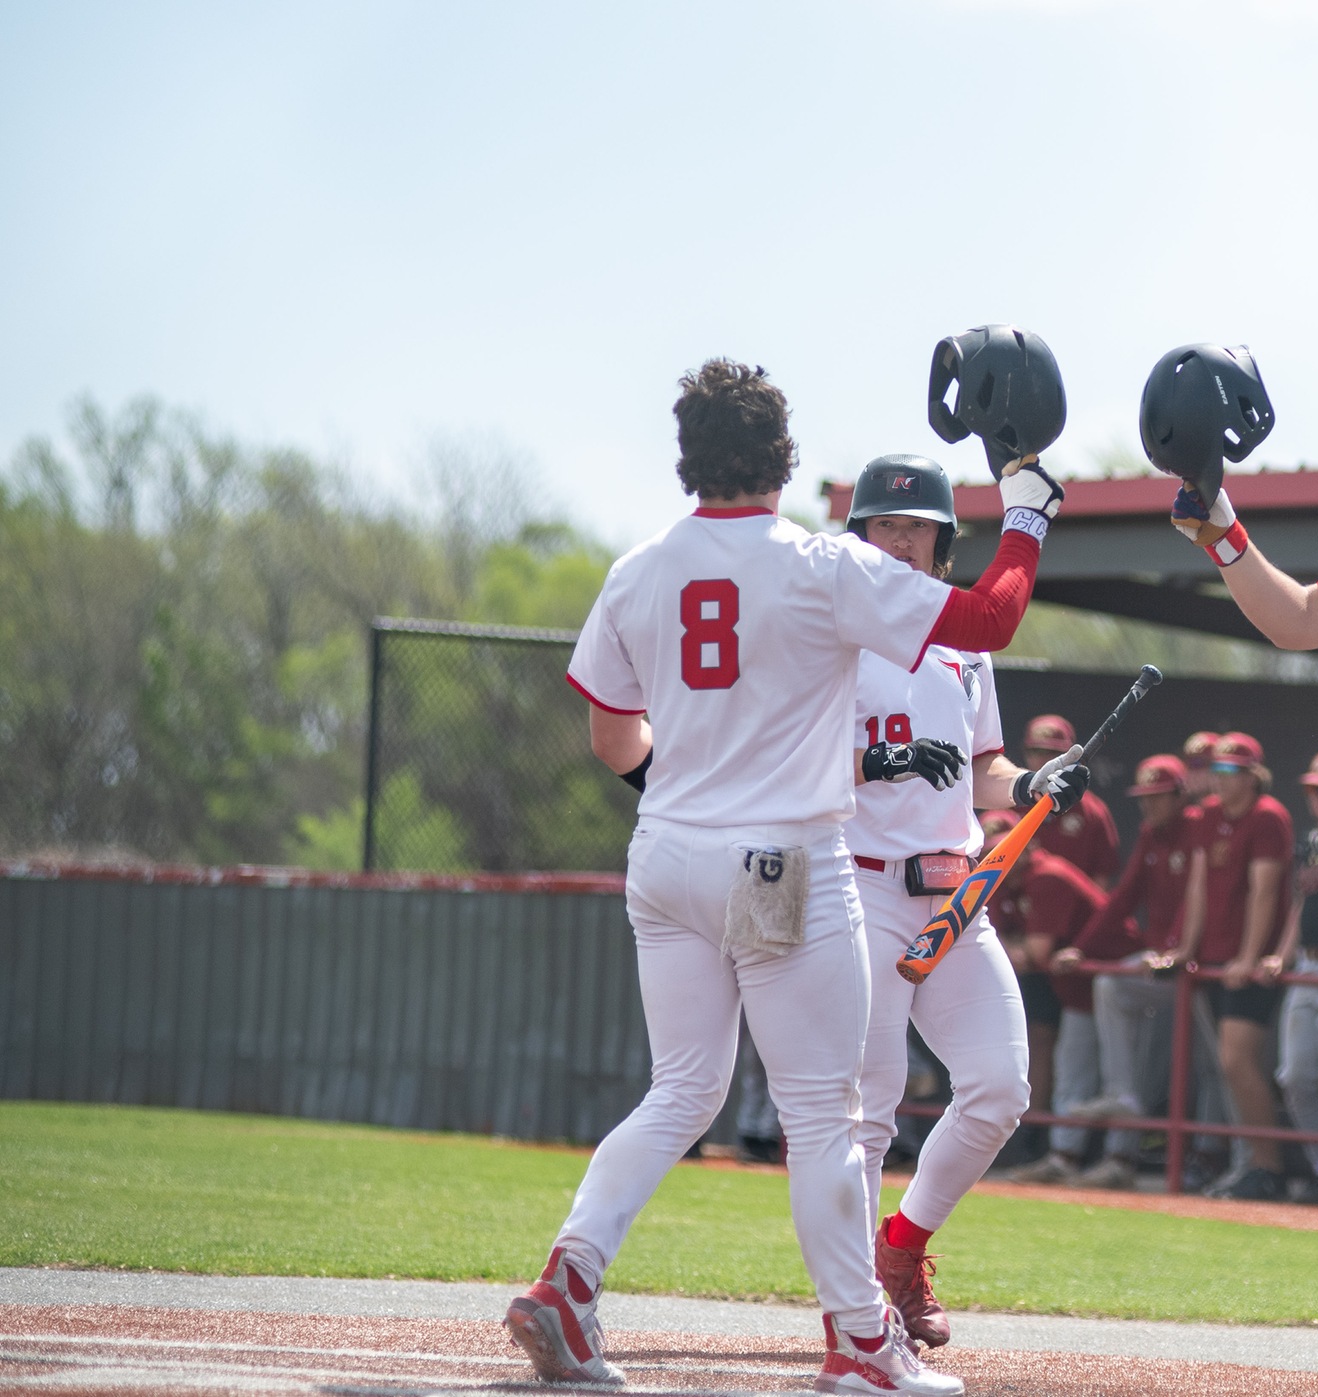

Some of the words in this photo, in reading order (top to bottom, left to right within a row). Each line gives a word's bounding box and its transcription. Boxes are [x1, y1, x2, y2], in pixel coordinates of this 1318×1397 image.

[1214, 375, 1228, 405] EASTON
[680, 578, 740, 690] 8
[865, 713, 913, 747] 19
